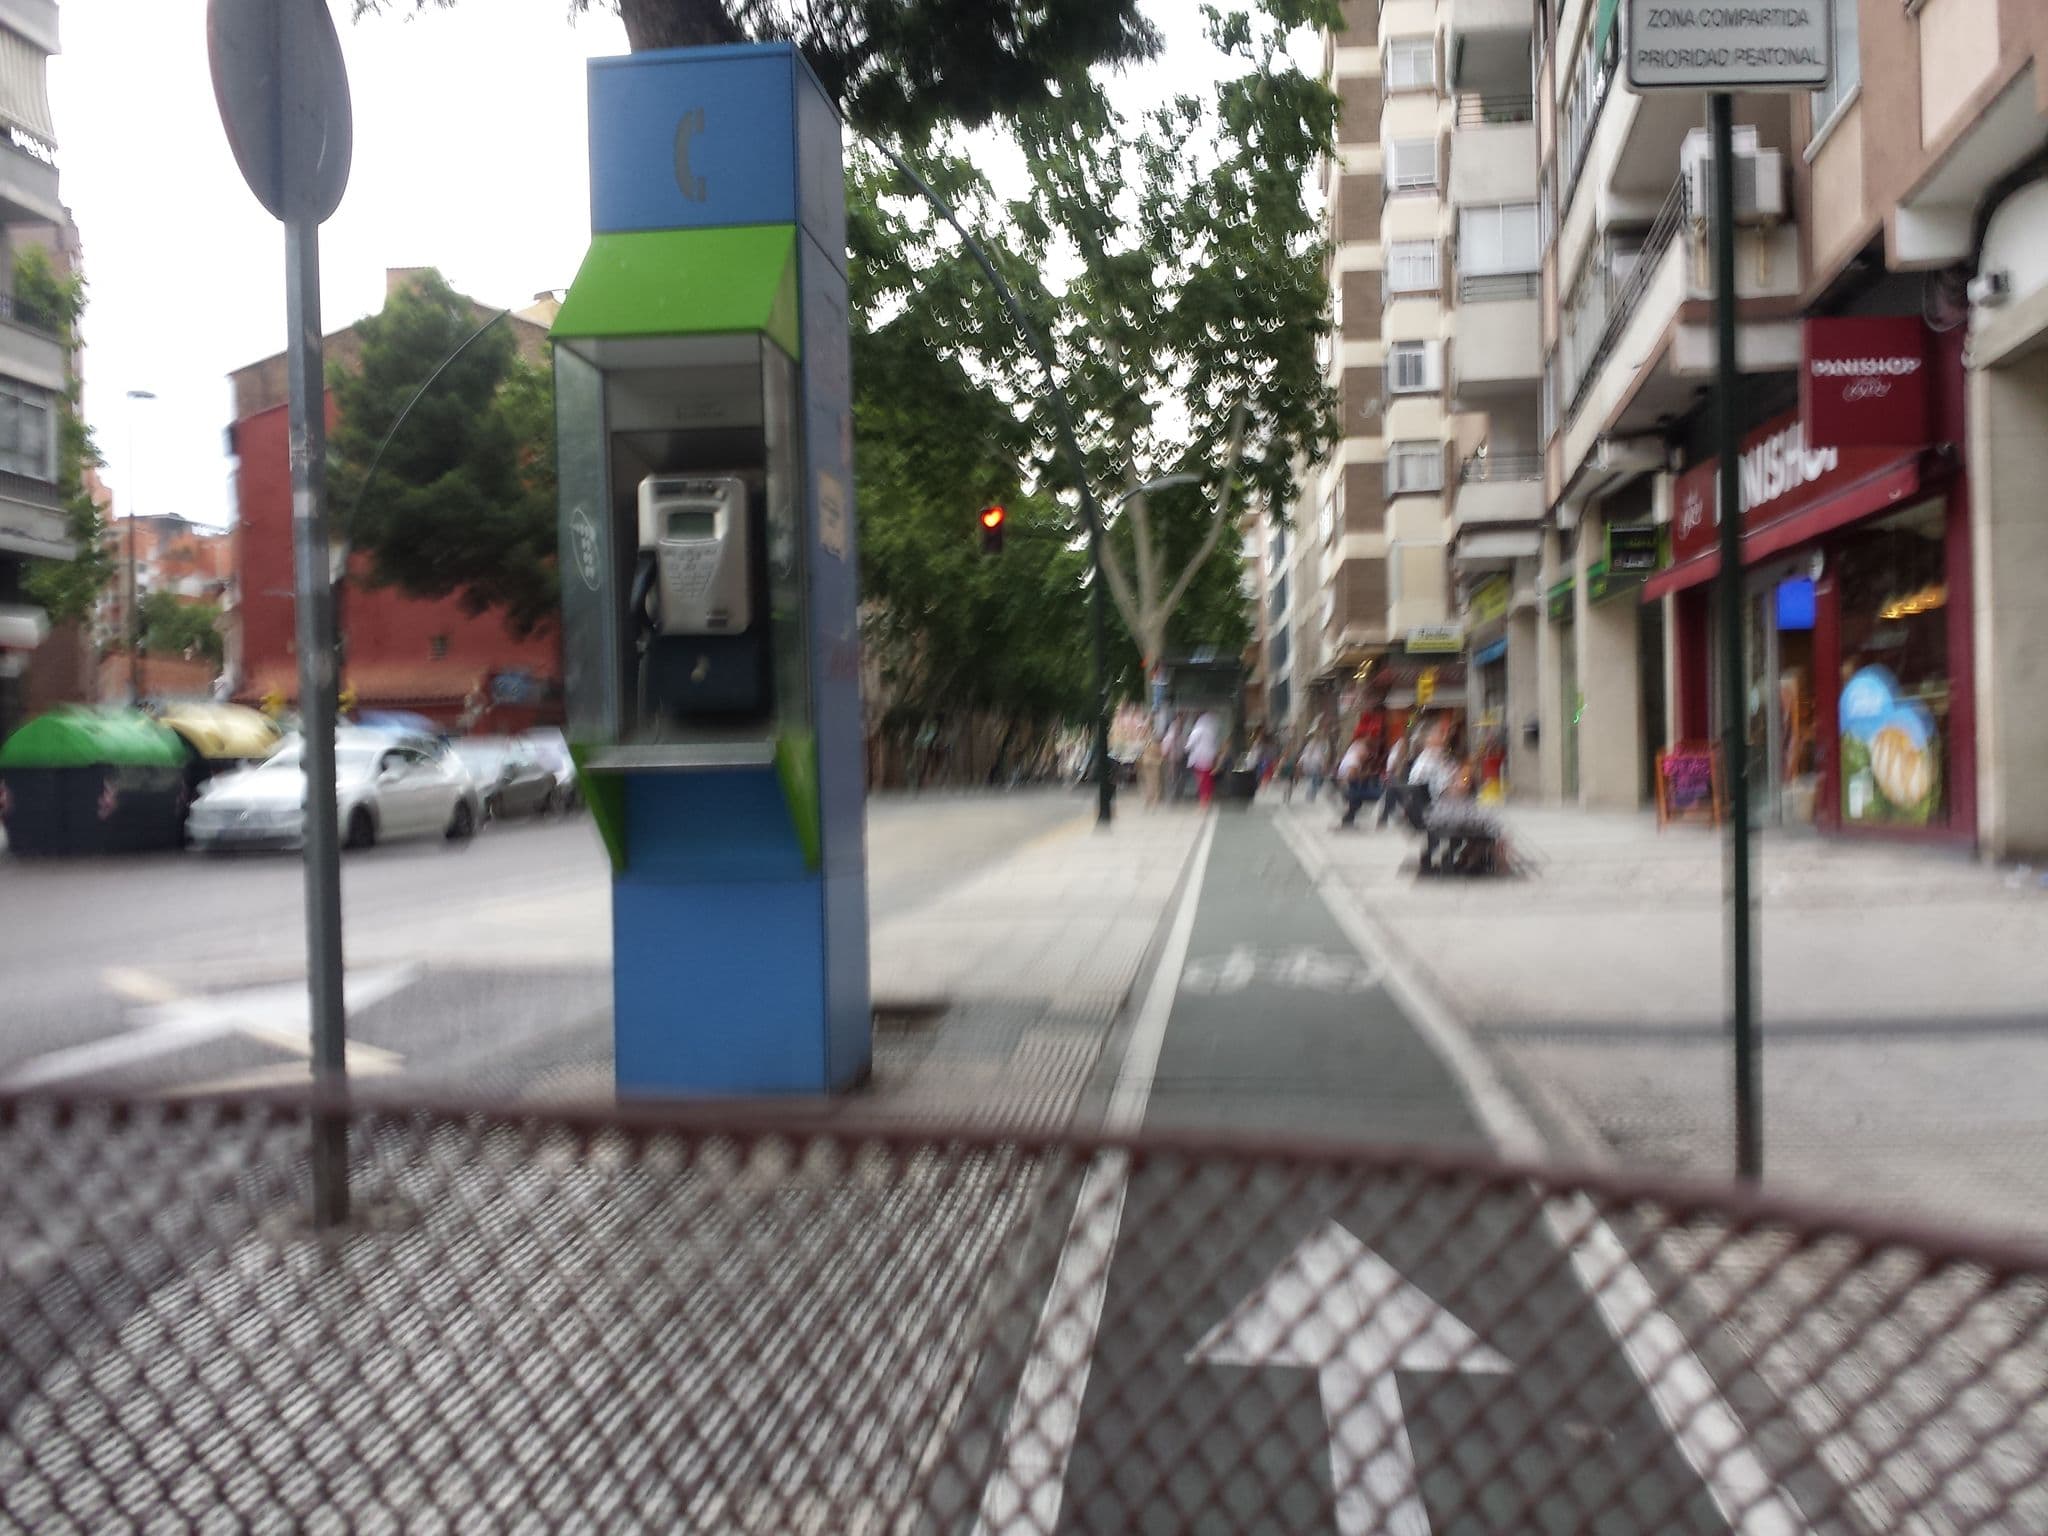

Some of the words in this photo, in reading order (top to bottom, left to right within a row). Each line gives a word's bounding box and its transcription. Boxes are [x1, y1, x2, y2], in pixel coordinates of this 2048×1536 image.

[1648, 8, 1695, 27] ZONA
[1700, 8, 1809, 27] COMPARTIDA
[1637, 49, 1729, 67] PRIORIDAD
[1734, 47, 1823, 66] PEATONAL
[1811, 358, 1921, 376] PANISHOP
